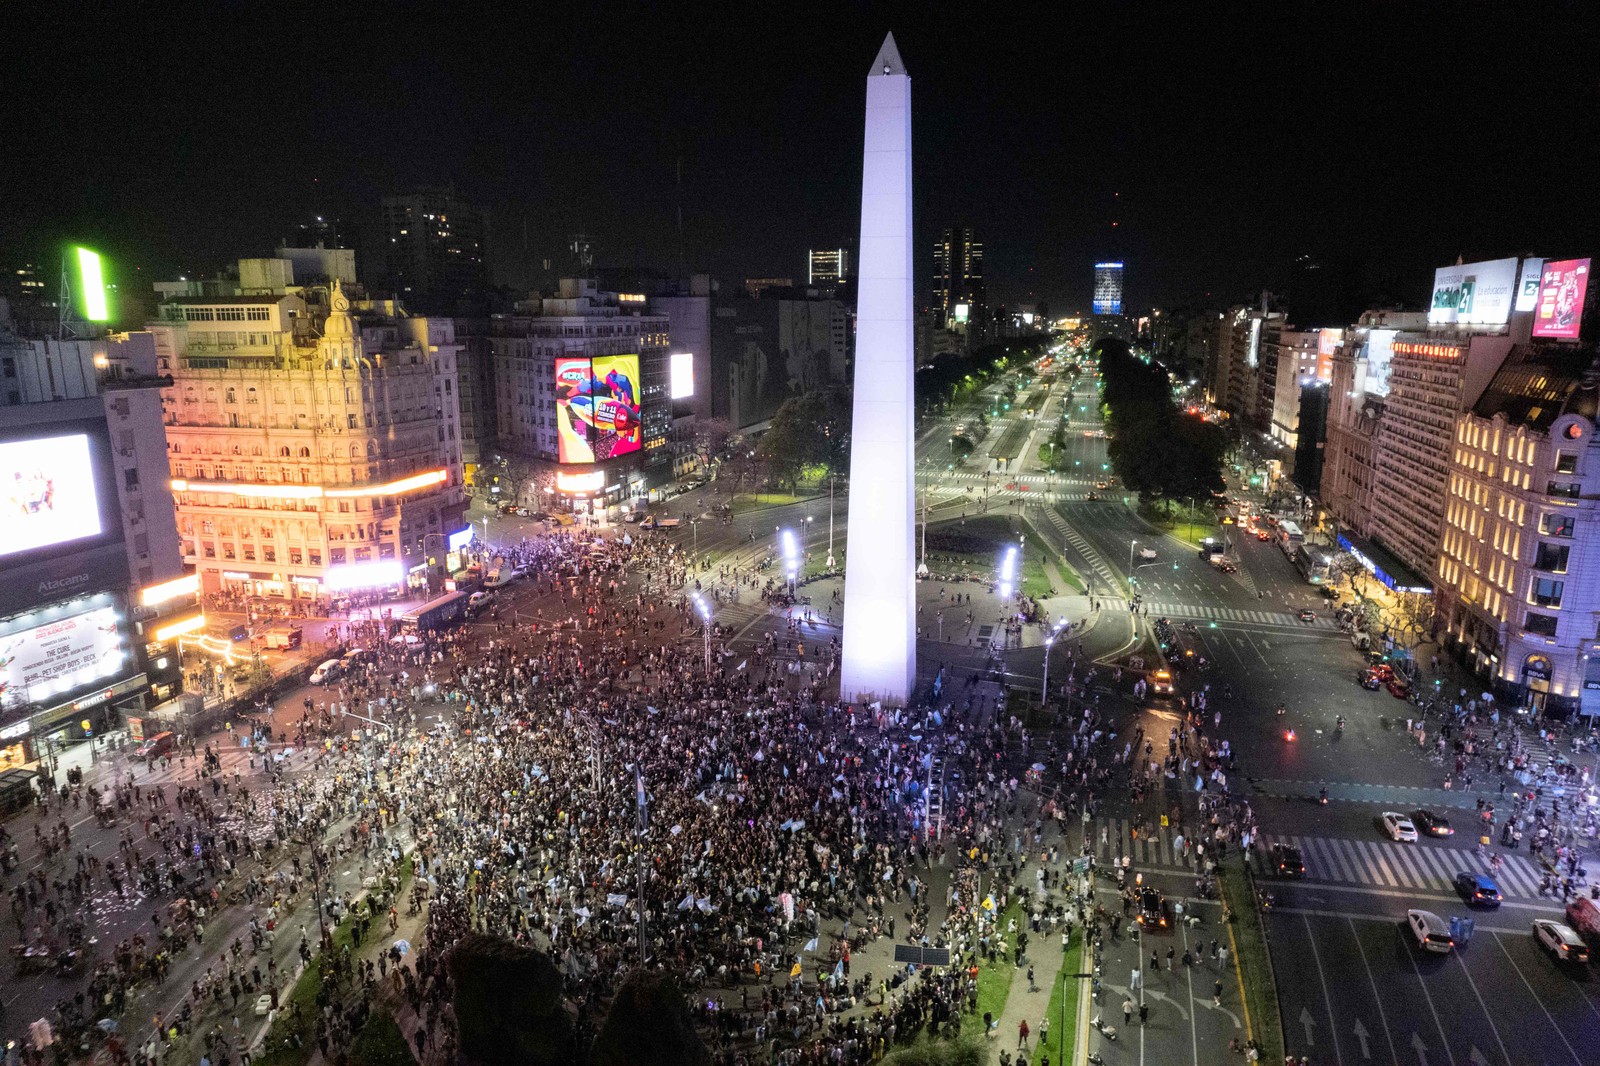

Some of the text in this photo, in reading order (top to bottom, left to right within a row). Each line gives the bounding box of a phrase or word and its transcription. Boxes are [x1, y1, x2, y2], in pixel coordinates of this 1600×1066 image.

[1460, 288, 1471, 313] 21
[38, 573, 89, 593] Atacama
[46, 649, 56, 658] THE
[56, 644, 70, 655] CURE
[41, 668, 52, 677] PET
[52, 663, 67, 674] SHOP
[67, 659, 81, 669] BOYS
[83, 653, 96, 663] BECK
[1527, 669, 1545, 678] BBVA
